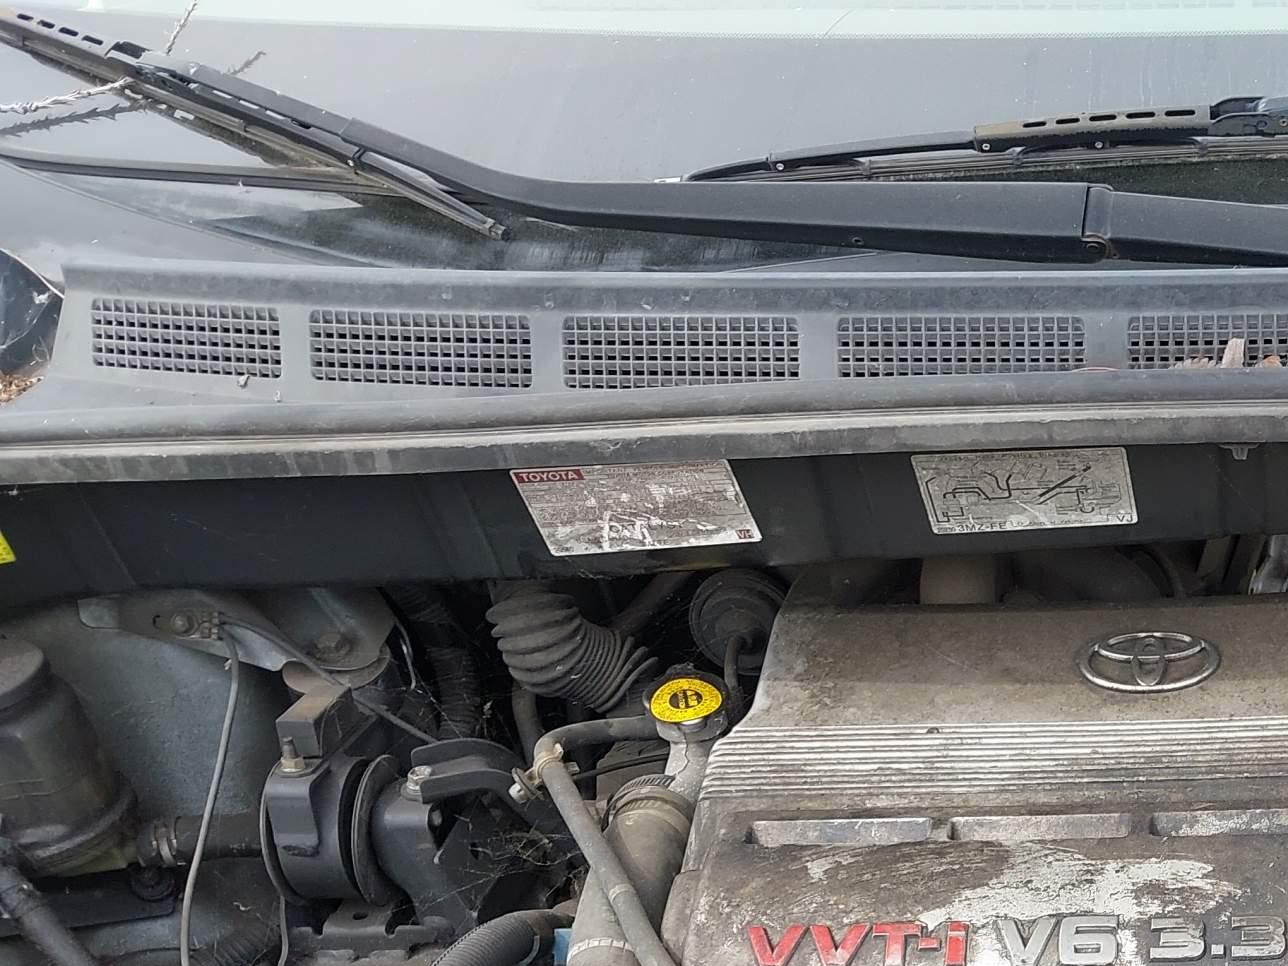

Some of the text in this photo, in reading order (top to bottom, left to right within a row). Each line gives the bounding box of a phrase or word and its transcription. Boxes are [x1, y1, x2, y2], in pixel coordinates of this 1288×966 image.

[518, 471, 578, 483] TOYOTA
[1116, 514, 1134, 523] VJ
[957, 521, 1007, 533] 3MZ-FE
[737, 529, 754, 539] VH
[1149, 915, 1288, 964] 3.3
